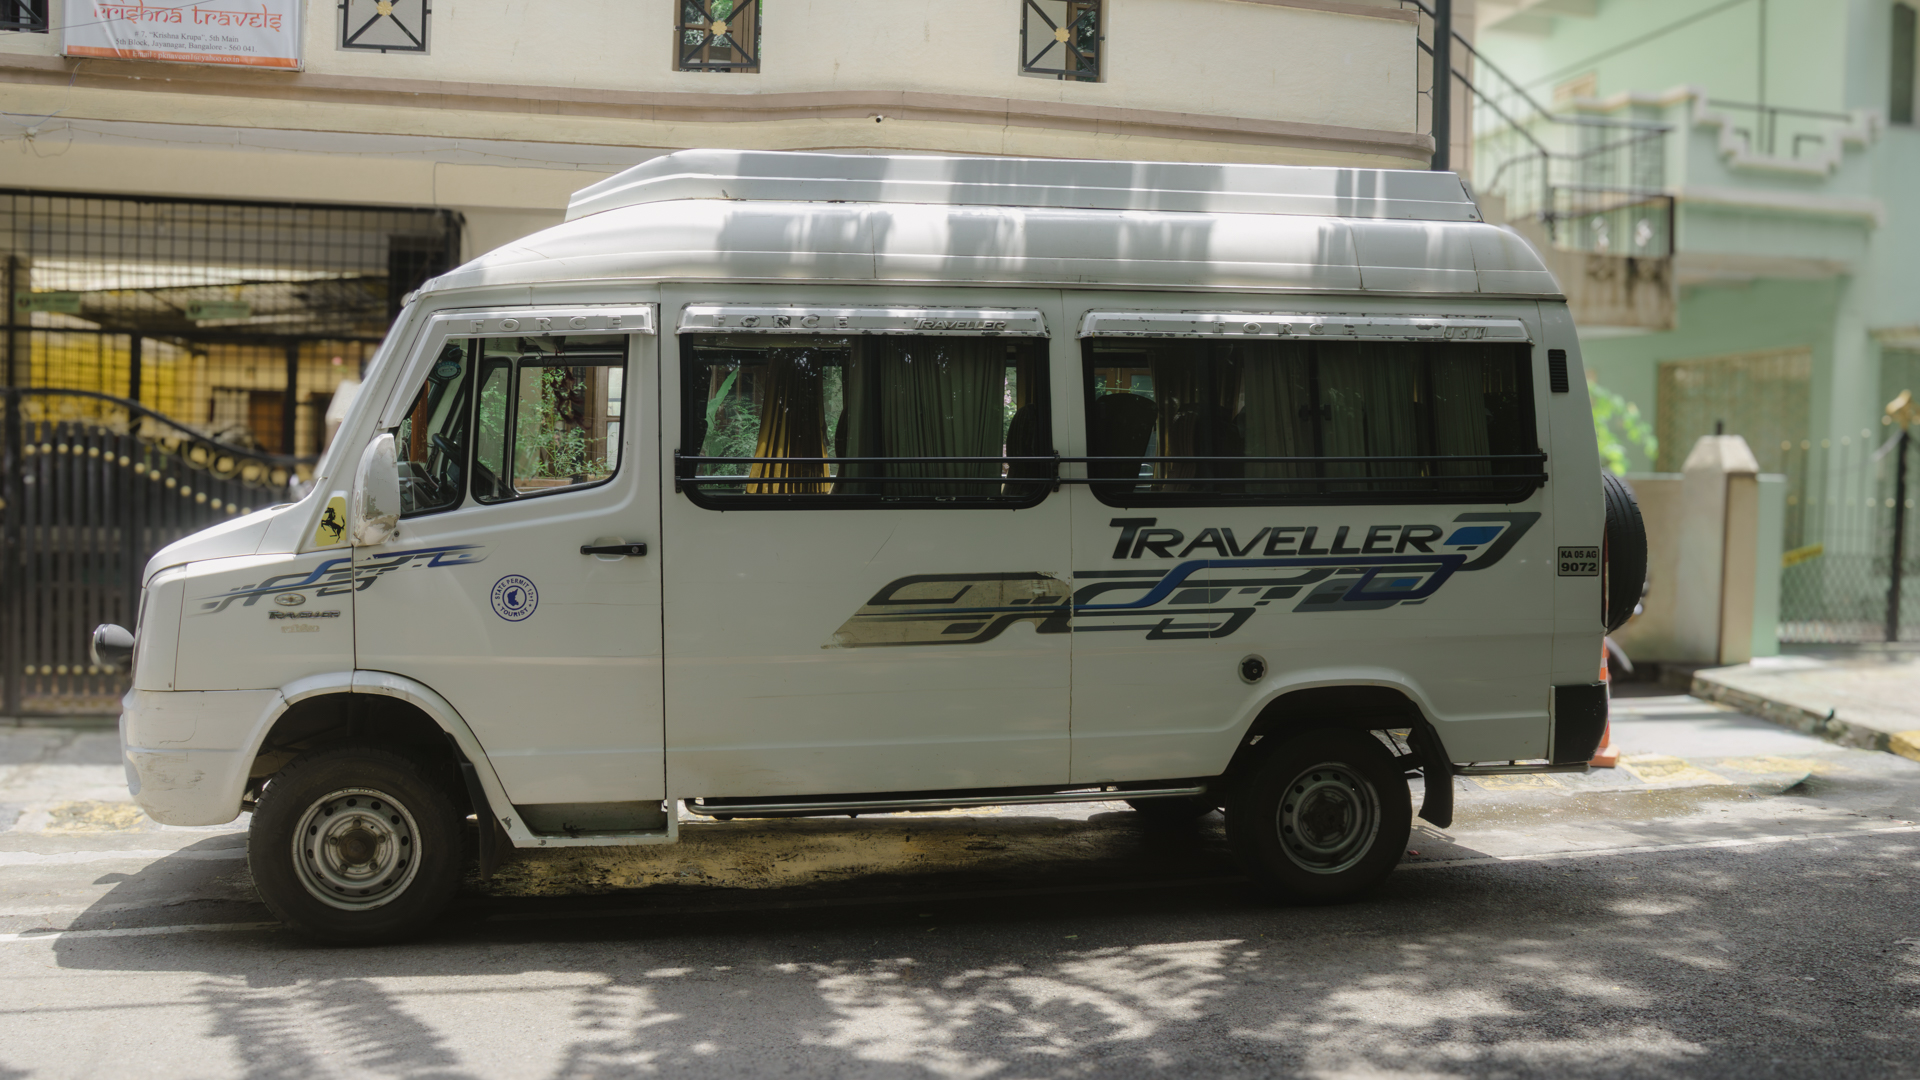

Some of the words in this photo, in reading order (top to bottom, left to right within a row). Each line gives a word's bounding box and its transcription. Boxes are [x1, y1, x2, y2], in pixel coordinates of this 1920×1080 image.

[191, 4, 282, 32] travels
[128, 39, 149, 47] Block,
[152, 40, 187, 49] Jayanagar,
[188, 42, 222, 51] Bangalore
[470, 315, 622, 333] FORCE
[713, 314, 849, 329] FORCE
[913, 317, 1007, 330] TRAVELLER
[1213, 321, 1356, 335] FORCE
[1109, 517, 1444, 560] TRAVELLER
[1561, 550, 1573, 559] KA
[1574, 550, 1584, 559] 05
[1585, 550, 1597, 559] AG
[1561, 562, 1597, 572] 9072
[494, 582, 507, 600] STATE
[506, 578, 529, 588] PERMIT
[268, 609, 341, 620] TRAVELLER
[500, 606, 529, 617] TOURIST
